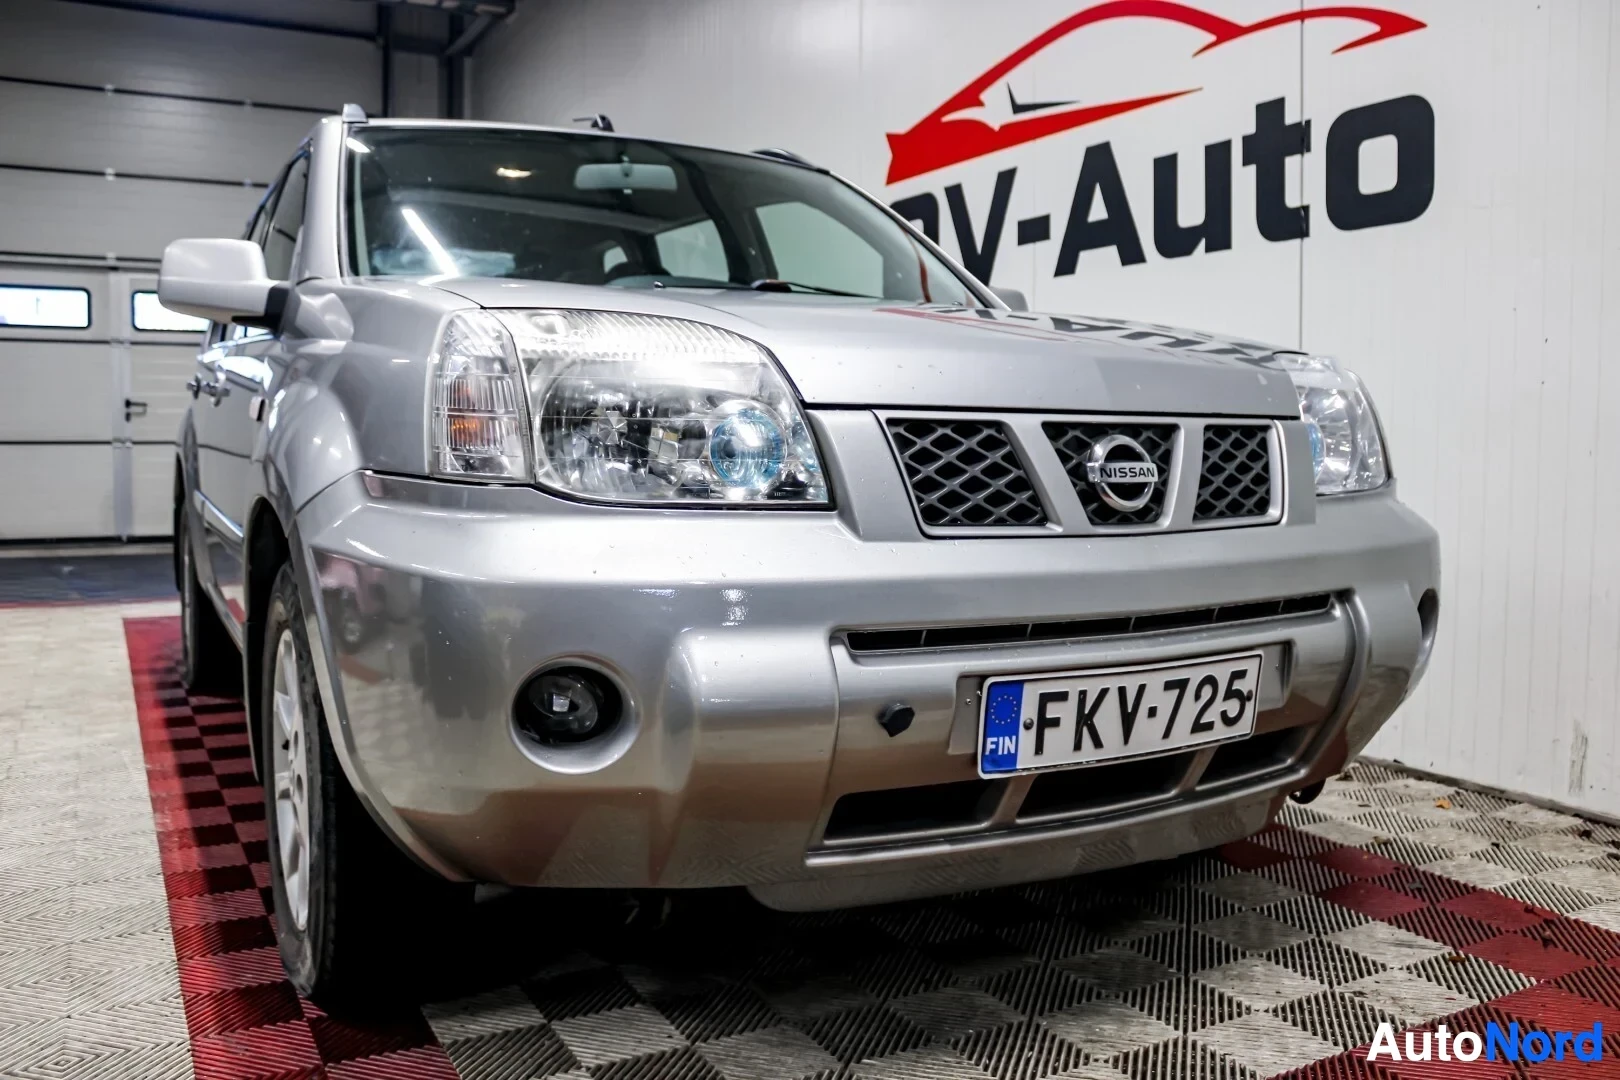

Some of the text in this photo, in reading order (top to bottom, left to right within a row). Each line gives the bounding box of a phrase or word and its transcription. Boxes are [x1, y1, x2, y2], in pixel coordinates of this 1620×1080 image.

[1100, 466, 1155, 479] NISSAN
[1033, 668, 1248, 756] FKV-725
[985, 735, 1017, 756] FIN
